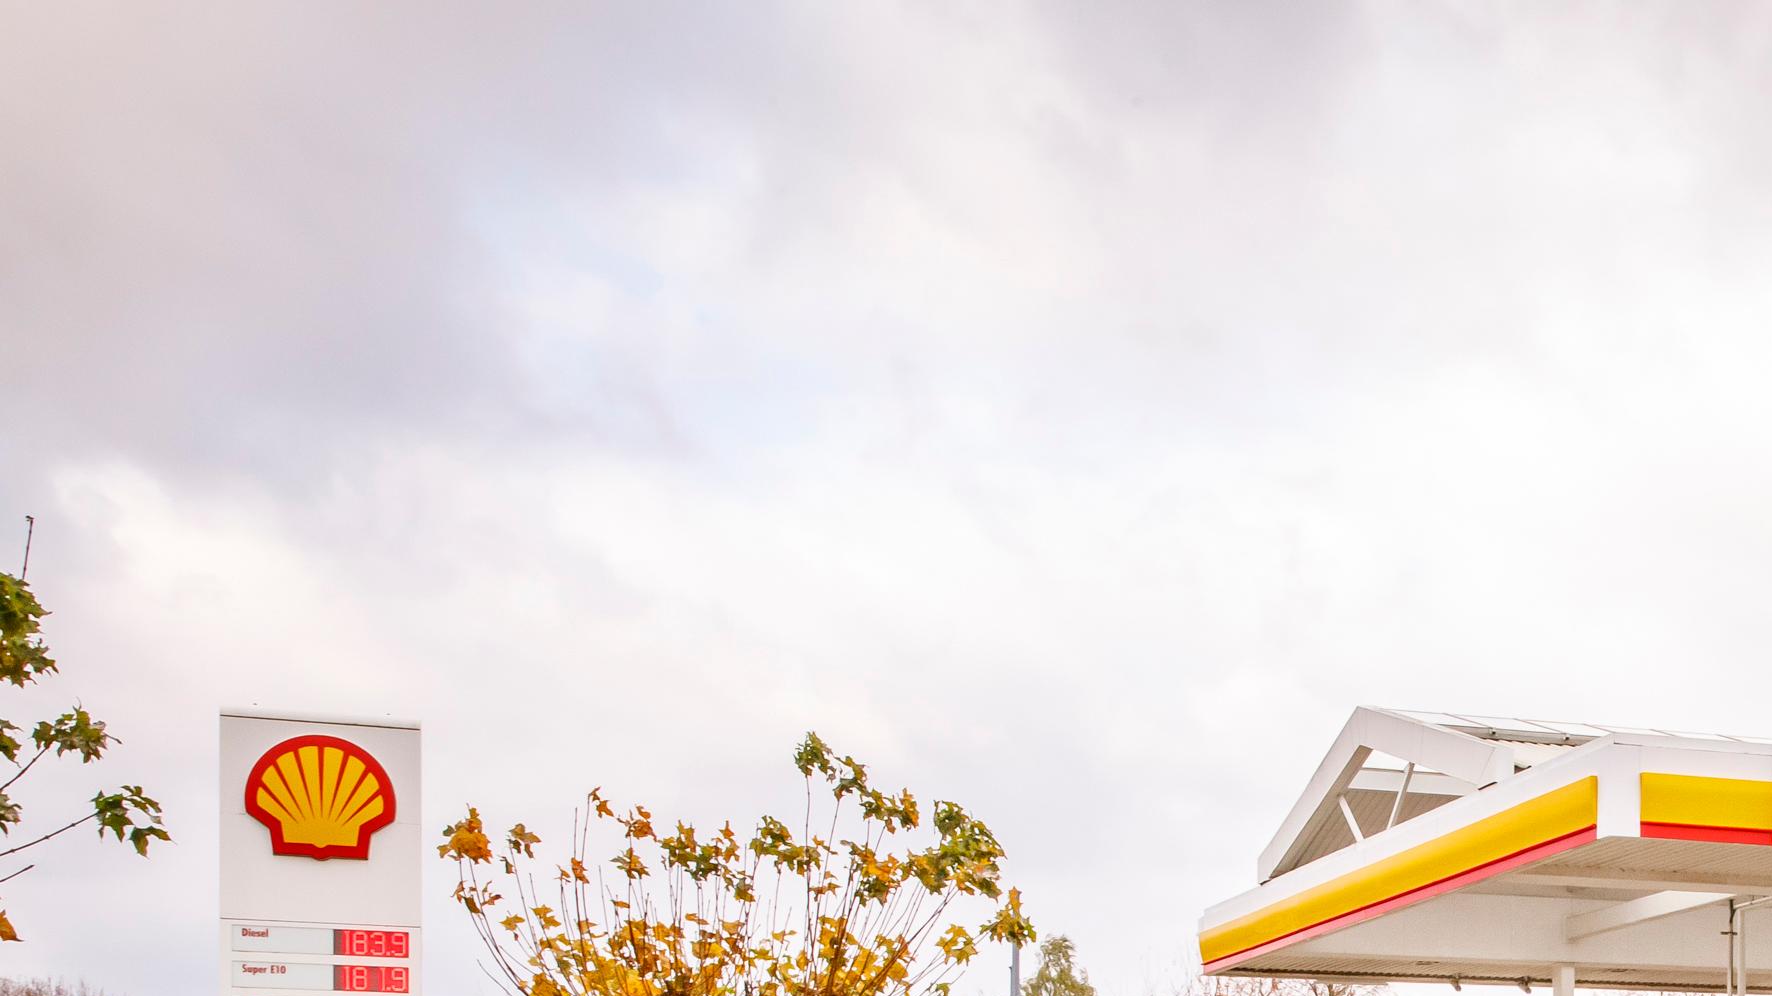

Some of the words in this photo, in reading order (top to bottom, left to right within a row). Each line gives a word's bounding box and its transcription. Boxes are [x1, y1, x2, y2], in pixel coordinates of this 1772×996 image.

[241, 928, 269, 938] Diesel
[343, 930, 407, 957] 183.9
[242, 964, 267, 975] Super
[270, 966, 286, 975] E10
[343, 966, 407, 992] 181.9
